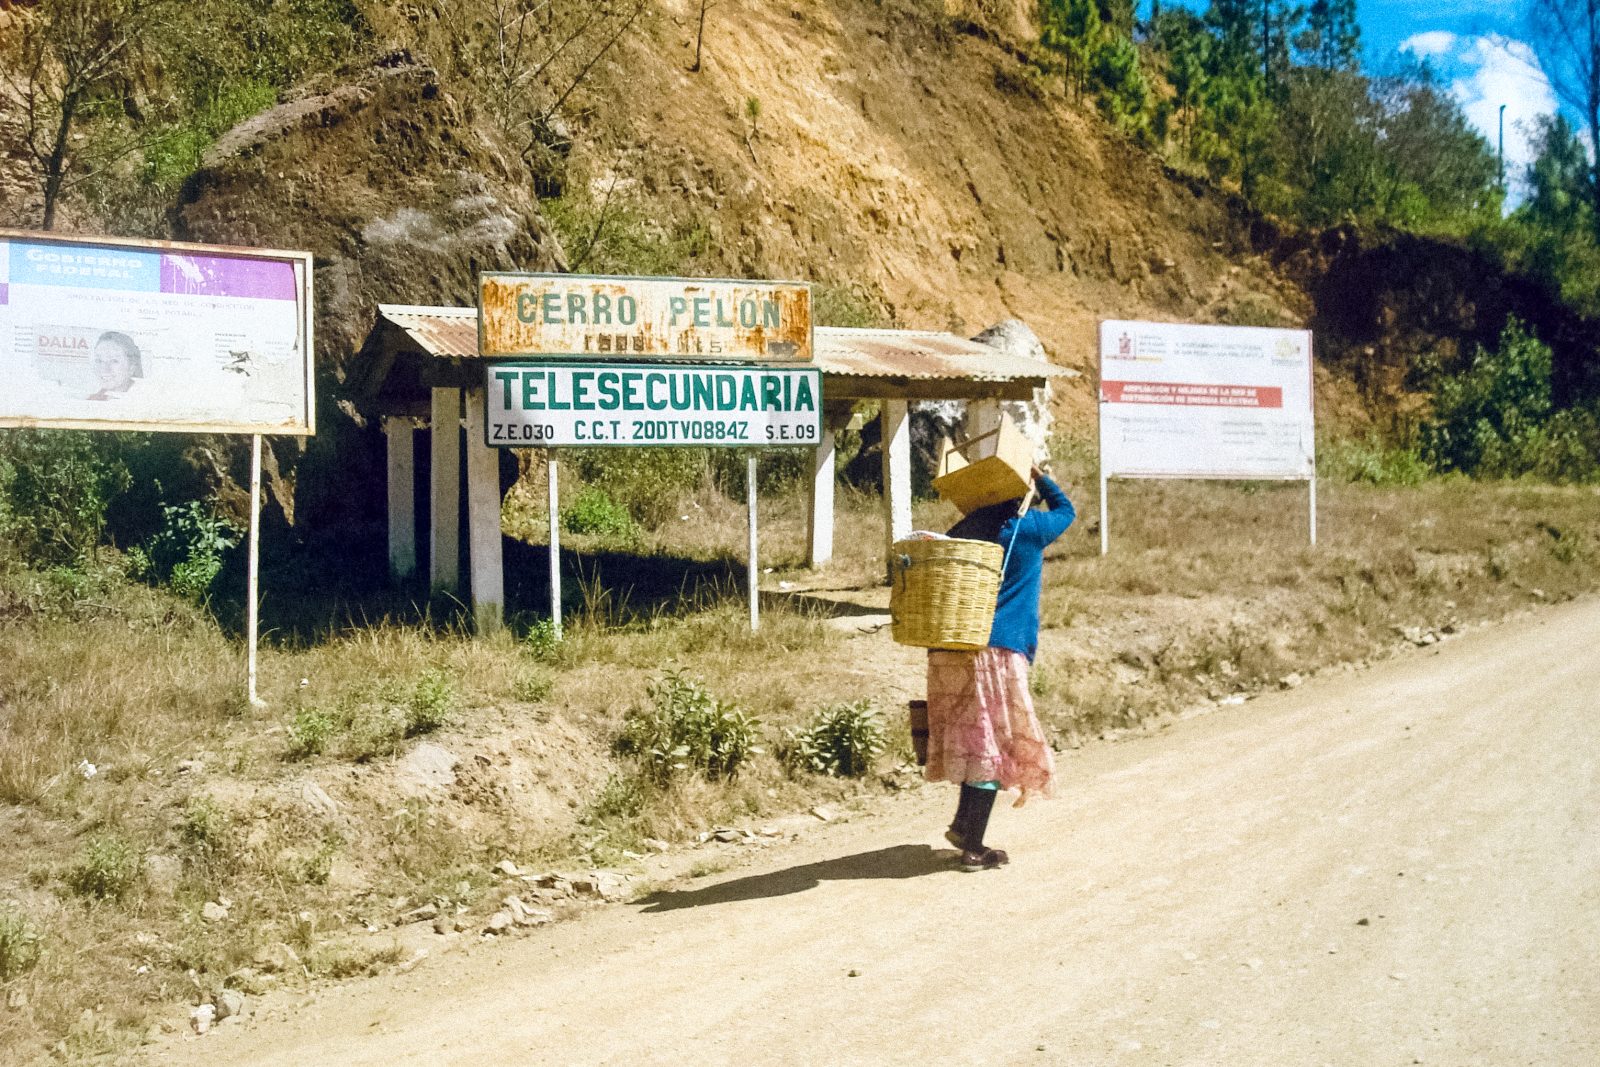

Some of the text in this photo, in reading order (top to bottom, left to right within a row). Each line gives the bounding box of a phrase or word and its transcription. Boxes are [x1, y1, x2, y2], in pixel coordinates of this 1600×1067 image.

[516, 290, 780, 328] CERRO PELÓN
[38, 336, 89, 350] DALIA
[495, 371, 814, 412] TELESECUNDARIA
[493, 424, 554, 440] Z.E.030
[574, 420, 626, 440] C.C.T.
[766, 424, 815, 440] S.E.09
